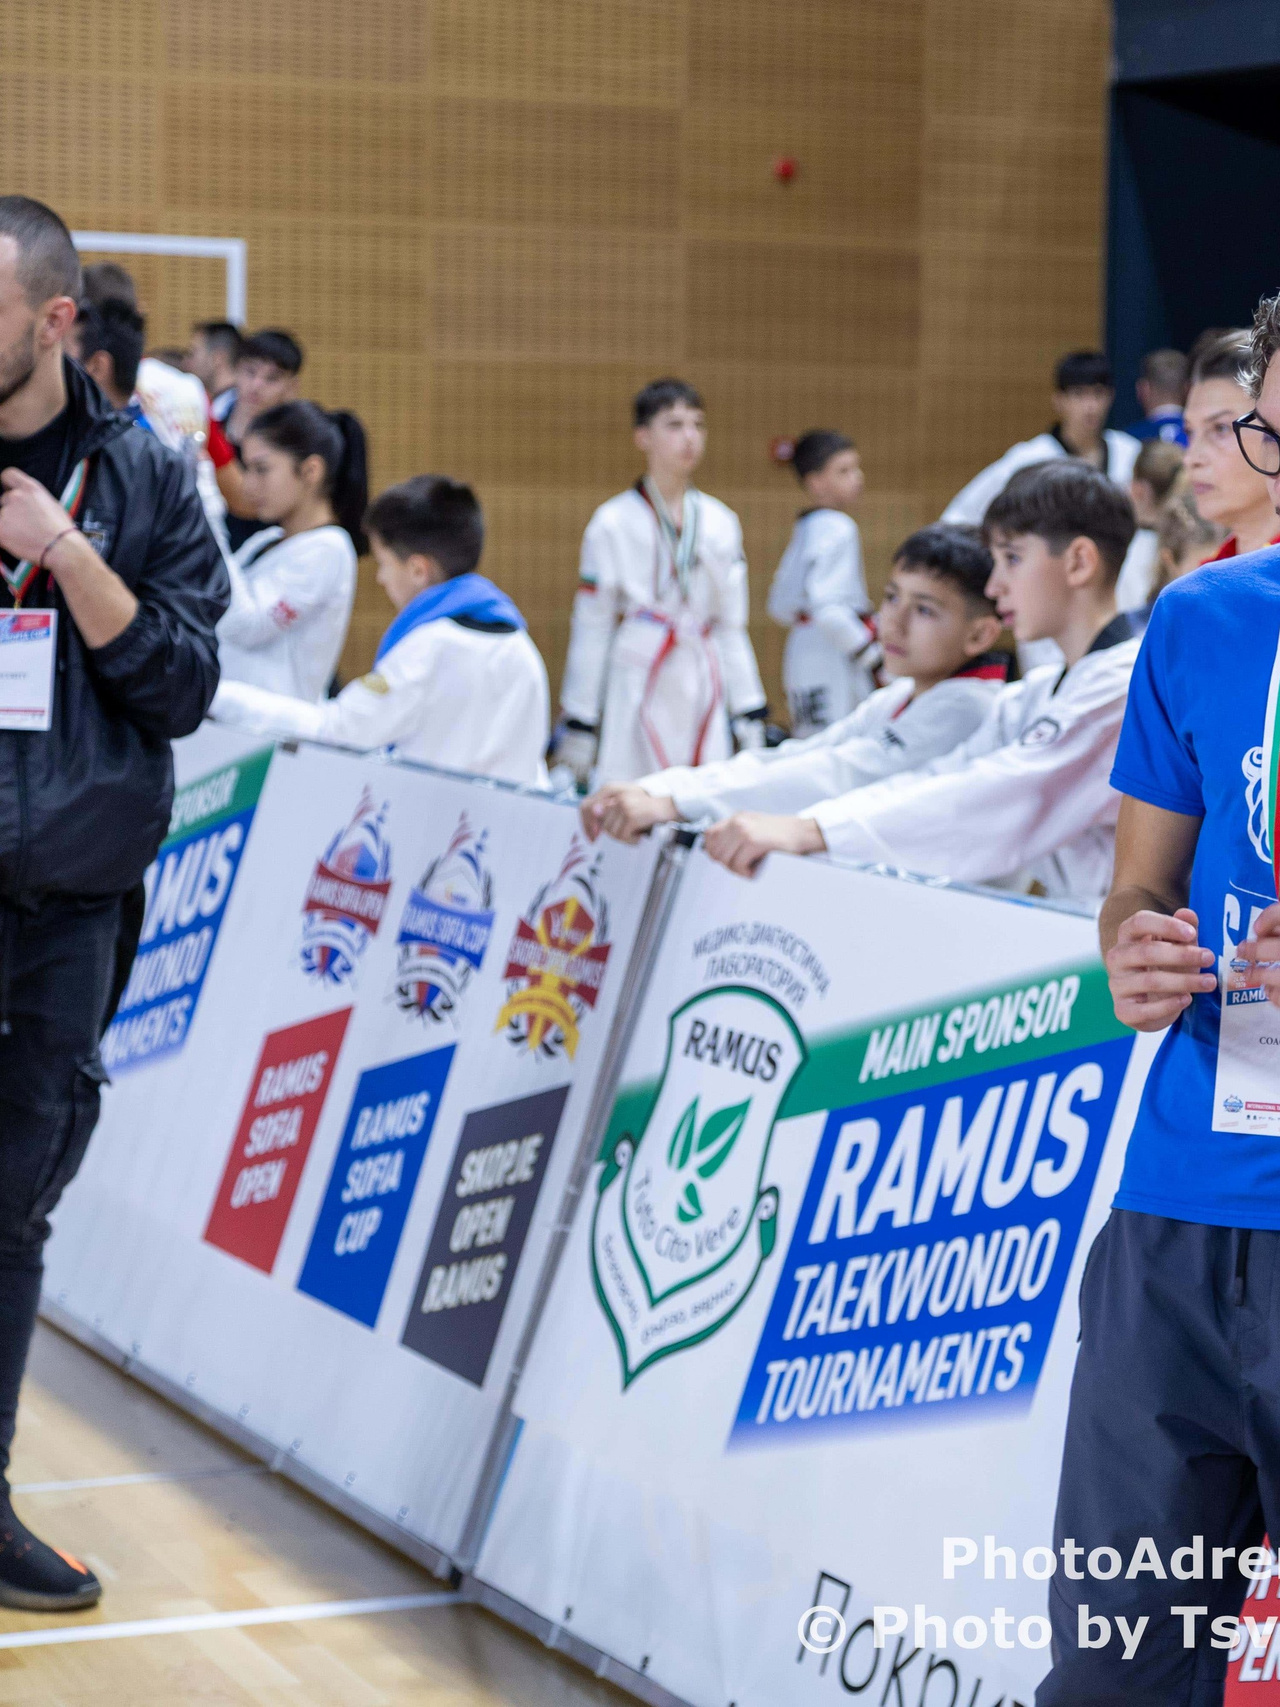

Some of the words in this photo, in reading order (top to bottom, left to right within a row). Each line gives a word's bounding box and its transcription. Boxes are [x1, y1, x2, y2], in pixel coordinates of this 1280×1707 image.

[859, 1012, 943, 1084] MAIN
[936, 975, 1081, 1063] SPONSOR
[1232, 988, 1270, 1004] RAMU
[683, 1019, 784, 1083] RAMUS
[807, 1062, 1104, 1245] RAMUS
[333, 1206, 382, 1257] CUP
[782, 1217, 1062, 1342] TAEKWONDO
[755, 1321, 1033, 1425] TOURNAMENTS
